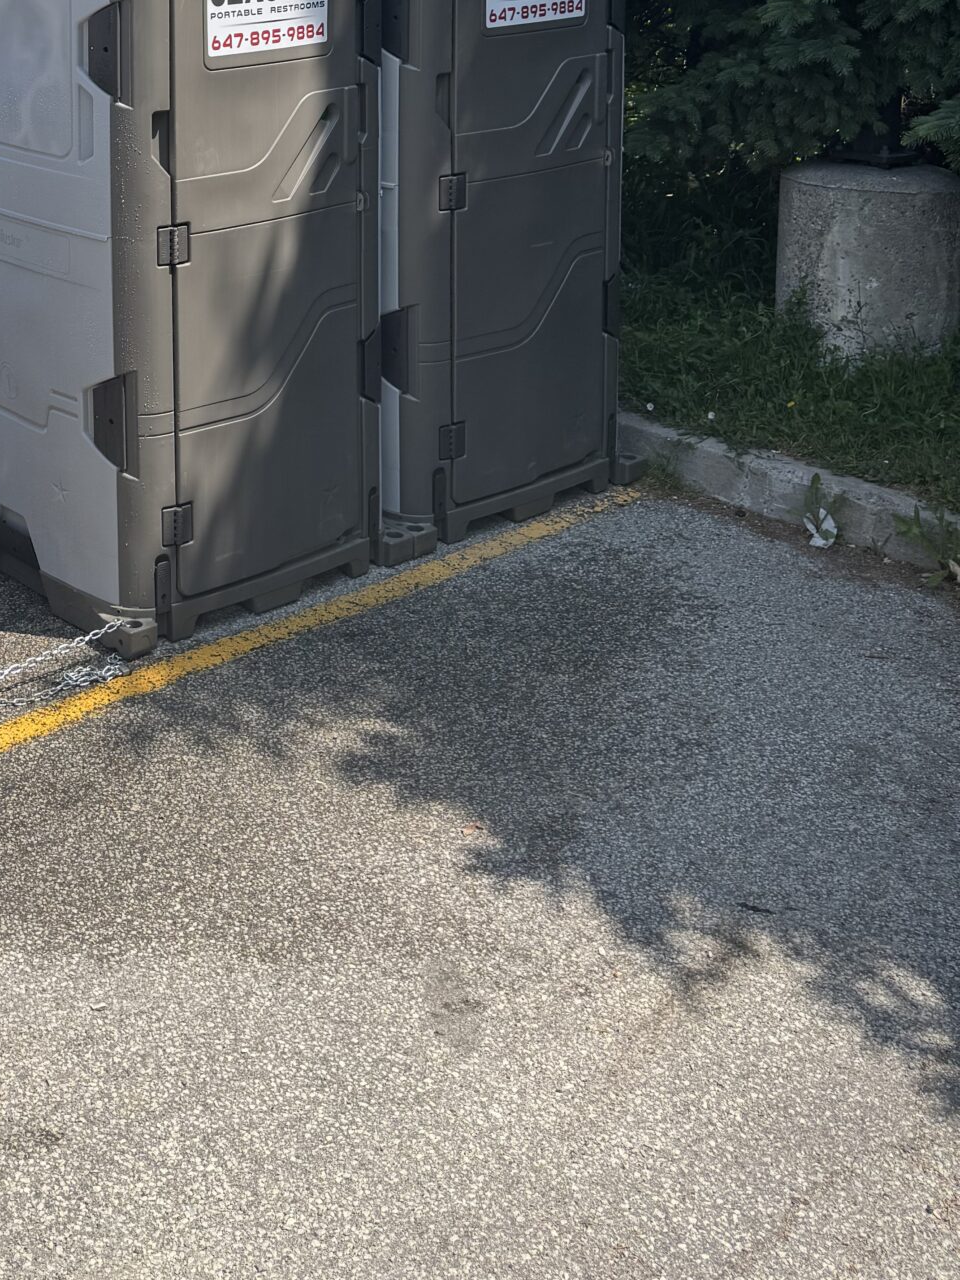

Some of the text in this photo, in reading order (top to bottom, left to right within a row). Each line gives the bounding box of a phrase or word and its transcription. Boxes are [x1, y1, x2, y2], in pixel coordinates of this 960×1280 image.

[210, 0, 325, 19] PORTABLE RESTROOMS
[489, 0, 582, 22] 647-895-9884
[212, 23, 324, 50] 647-895-9884
